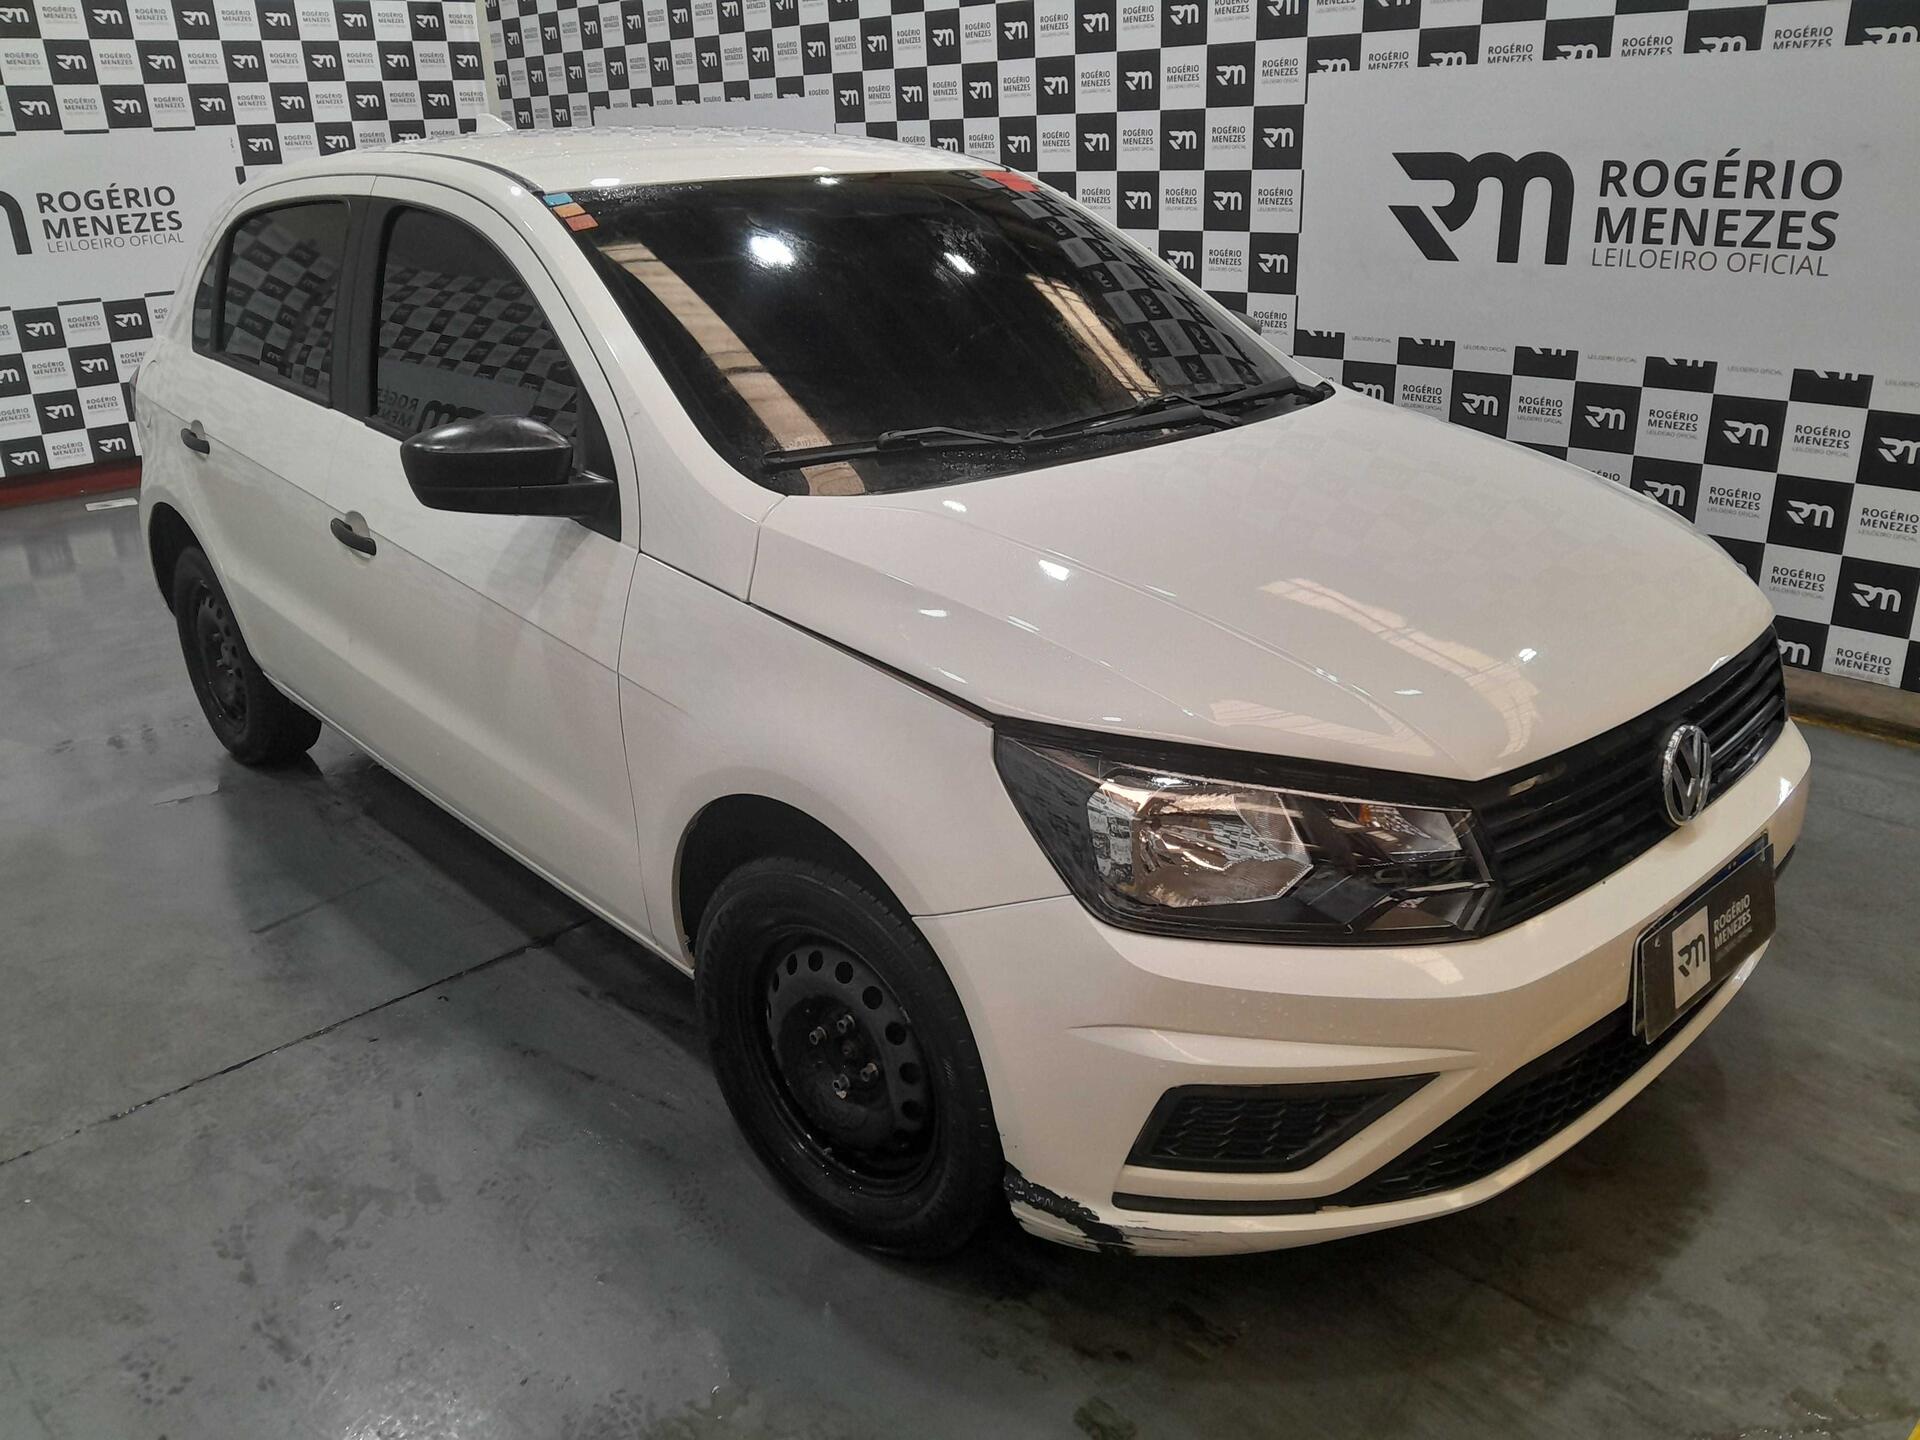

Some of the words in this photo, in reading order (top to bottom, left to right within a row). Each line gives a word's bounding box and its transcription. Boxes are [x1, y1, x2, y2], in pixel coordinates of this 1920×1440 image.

[1123, 5, 1154, 15] ROGÉRIO
[1215, 4, 1249, 15] MENEZES
[1040, 14, 1068, 23] ROGÉRIO
[1123, 14, 1154, 24] MENEZES
[965, 22, 991, 30] ROGÉRIO
[1040, 22, 1068, 31] MENEZES
[897, 29, 920, 37] ROGÉRIO
[965, 30, 991, 38] MENEZES
[1774, 26, 1833, 39] ROGÉRIO
[1622, 35, 1673, 48] ROGÉRIO
[1488, 43, 1533, 55] ROGÉRIO
[1369, 51, 1409, 61] ROGÉRIO
[1262, 58, 1298, 68] ROGÉRIO
[1167, 64, 1199, 74] ROGÉRIO
[1262, 67, 1298, 77] MENEZES
[1003, 76, 1030, 84] ROGÉRIO
[1081, 71, 1110, 79] ROGÉRIO
[1167, 73, 1199, 83] MENEZES
[933, 81, 957, 89] ROGÉRIO
[1003, 83, 1030, 92] MENEZES
[1081, 79, 1110, 87] MENEZES
[933, 88, 957, 96] MENEZES
[1042, 131, 1070, 140] ROGÉRIO
[1123, 129, 1153, 137] ROGÉRIO
[1212, 126, 1245, 135] ROGÉRIO
[969, 133, 994, 142] ROGÉRIO
[1123, 137, 1153, 145] MENEZES
[1212, 134, 1246, 143] MENEZES
[969, 141, 994, 149] MENEZES
[1042, 139, 1070, 147] MENEZES
[1599, 148, 1842, 200] ROGÉRIO
[1165, 188, 1197, 196] ROGÉRIO
[1258, 187, 1293, 197] ROGÉRIO
[36, 183, 175, 213] ROGÉRIO
[1082, 195, 1111, 204] MENEZES
[1166, 196, 1197, 205] MENEZES
[1258, 197, 1293, 206] MENEZES
[42, 211, 182, 239] MENEZES
[1594, 207, 1839, 250] MENEZES
[47, 236, 125, 253] LEILOEIRO
[1209, 248, 1242, 258] ROGÉRIO
[1209, 257, 1242, 266] MENEZES
[1592, 248, 1718, 271] LEILOEIRO
[1726, 252, 1829, 276] OFICIAL
[1254, 311, 1287, 320] ROGÉRIO
[1403, 384, 1442, 395] ROGÉRIO
[1402, 394, 1441, 404] MENEZES
[1519, 396, 1563, 408] ROGÉRIO
[1518, 405, 1562, 417] MENEZES
[1649, 409, 1698, 422] ROGÉRIO
[1648, 419, 1697, 432] MENEZES
[1795, 424, 1850, 439] ROGÉRIO
[1794, 435, 1850, 449] MENEZES
[1710, 487, 1761, 501] ROGÉRIO
[1709, 496, 1760, 511] MENEZES
[1862, 507, 1919, 523] ROGÉRIO
[1860, 517, 1917, 534] MENEZES
[1772, 566, 1825, 582] ROGÉRIO
[1771, 575, 1824, 592] MENEZES
[1836, 648, 1891, 666] ROGÉRIO
[1835, 657, 1890, 676] MENEZES
[1714, 894, 1750, 933] ROGÉRIO
[1714, 910, 1751, 949] MENEZES
